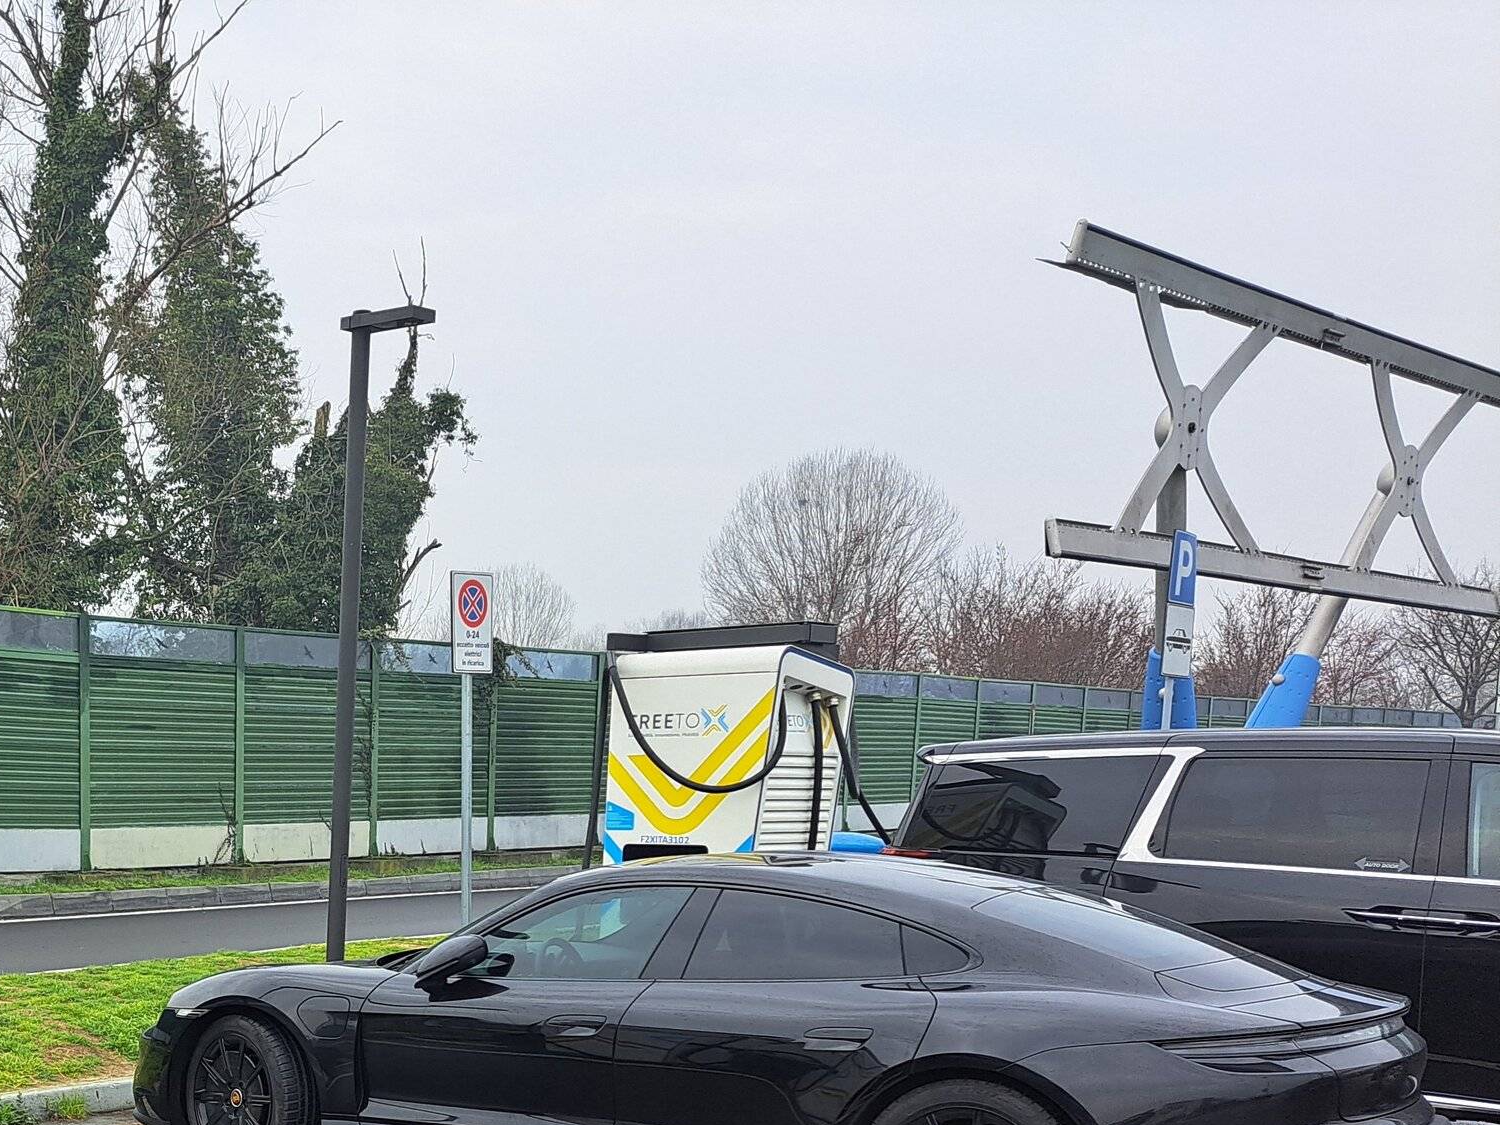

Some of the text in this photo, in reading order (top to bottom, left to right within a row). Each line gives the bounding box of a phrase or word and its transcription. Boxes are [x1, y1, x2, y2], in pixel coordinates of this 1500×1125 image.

[1174, 540, 1193, 596] P
[466, 630, 480, 639] 0-24
[641, 835, 689, 844] F2XITA3102
